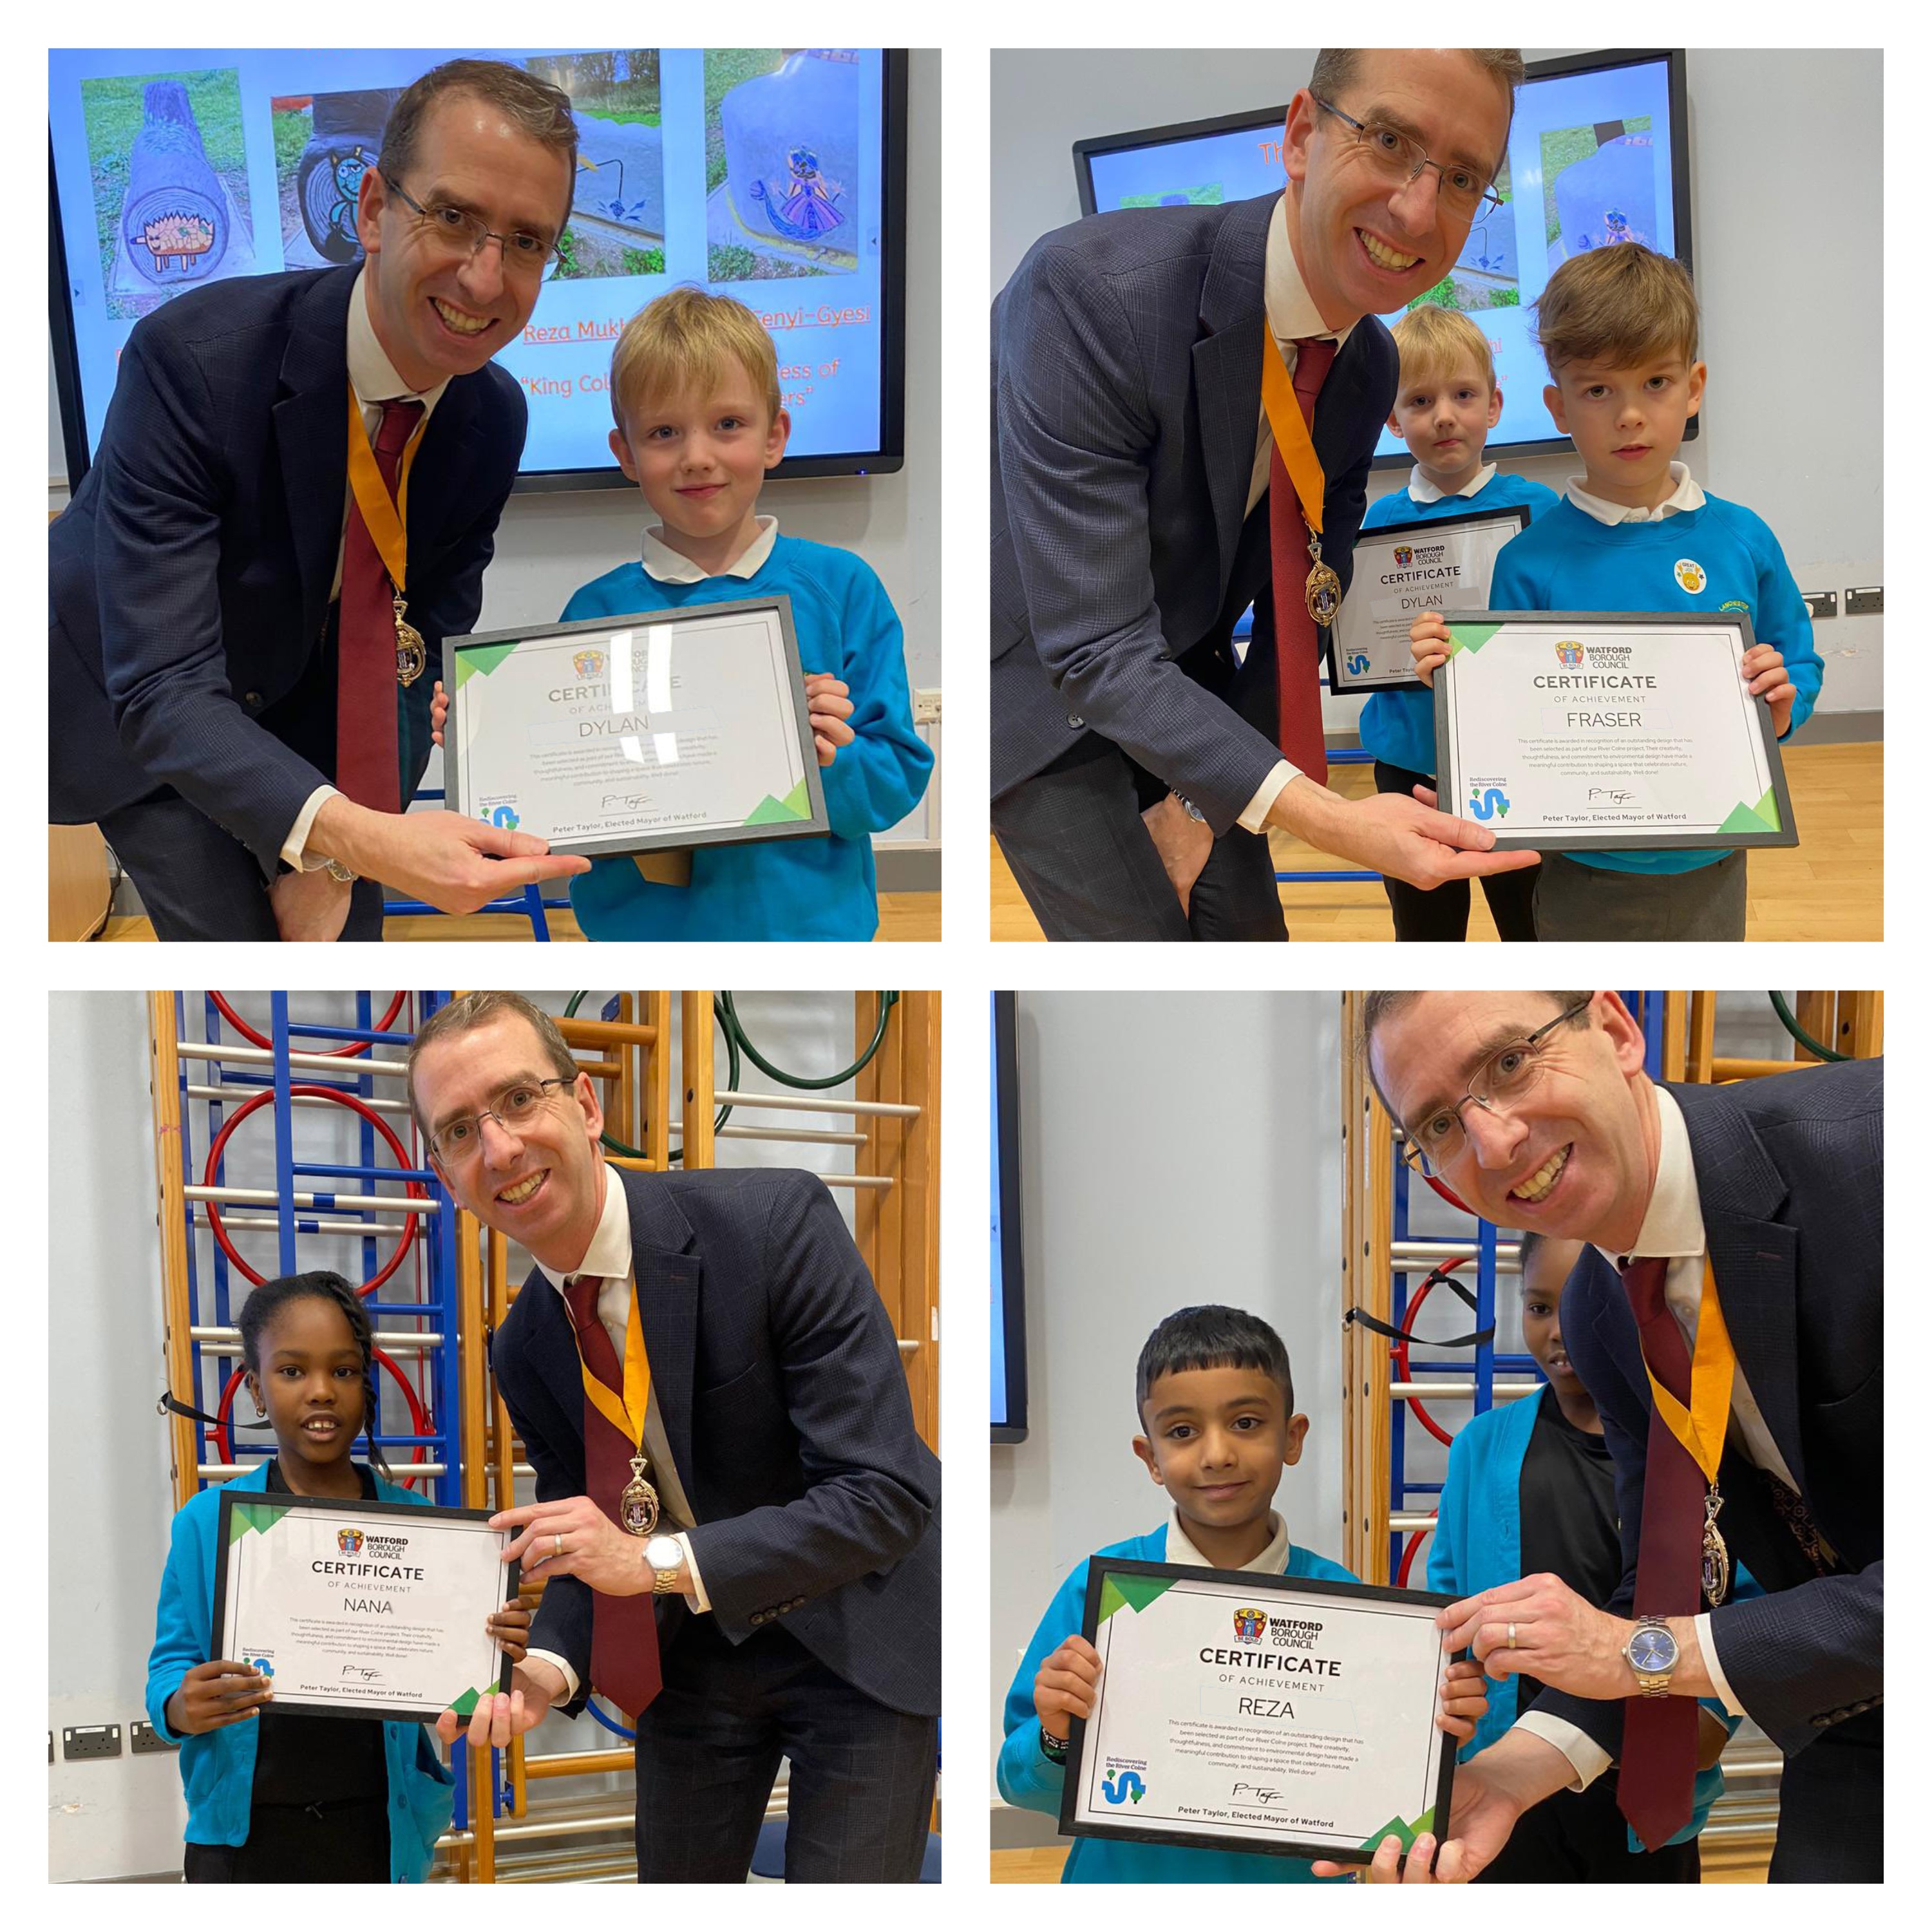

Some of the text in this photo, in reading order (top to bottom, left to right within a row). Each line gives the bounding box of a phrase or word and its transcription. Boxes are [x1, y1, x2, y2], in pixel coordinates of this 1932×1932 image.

[524, 324, 570, 342] Reza
[819, 357, 840, 378] of
[578, 373, 611, 392] Col
[1414, 545, 1444, 554] WATFORD
[1416, 551, 1444, 560] BOROUGH
[1418, 557, 1442, 565] COUNCIL
[1380, 566, 1461, 584] CERTIFICATE
[1405, 582, 1454, 592] ACHIEVEMENT
[1401, 594, 1443, 609] DYLAN
[1532, 676, 1657, 688] CERTIFICATE
[579, 715, 649, 737] DYLAN
[1567, 712, 1642, 728] FRASER
[576, 822, 603, 831] Taylor,
[605, 819, 635, 828] Elected
[636, 816, 661, 826] Mayor
[673, 812, 707, 821] Watford
[365, 1535, 408, 1545] WATFORD
[367, 1543, 404, 1552] BOROUGH
[368, 1550, 402, 1560] COUNCIL
[311, 1560, 424, 1580] CERTIFICATE
[344, 1582, 411, 1593] ACHIEVEMENT
[344, 1598, 393, 1615] NANA
[1269, 1617, 1323, 1631] WATFORD
[1271, 1627, 1318, 1640] BOROUGH
[1272, 1636, 1314, 1649] COUNCIL
[1198, 1647, 1341, 1677] CERTIFICATE
[1218, 1674, 1325, 1692] OF ACHIEVEMENT
[1238, 1696, 1296, 1719] REZA
[1106, 1756, 1147, 1765] Rediscovering
[1177, 1806, 1200, 1814] Peter
[1202, 1808, 1229, 1819] Taylor,
[1231, 1811, 1262, 1820] Elected
[1263, 1814, 1288, 1824] Mayor
[1301, 1817, 1334, 1827] Watford
